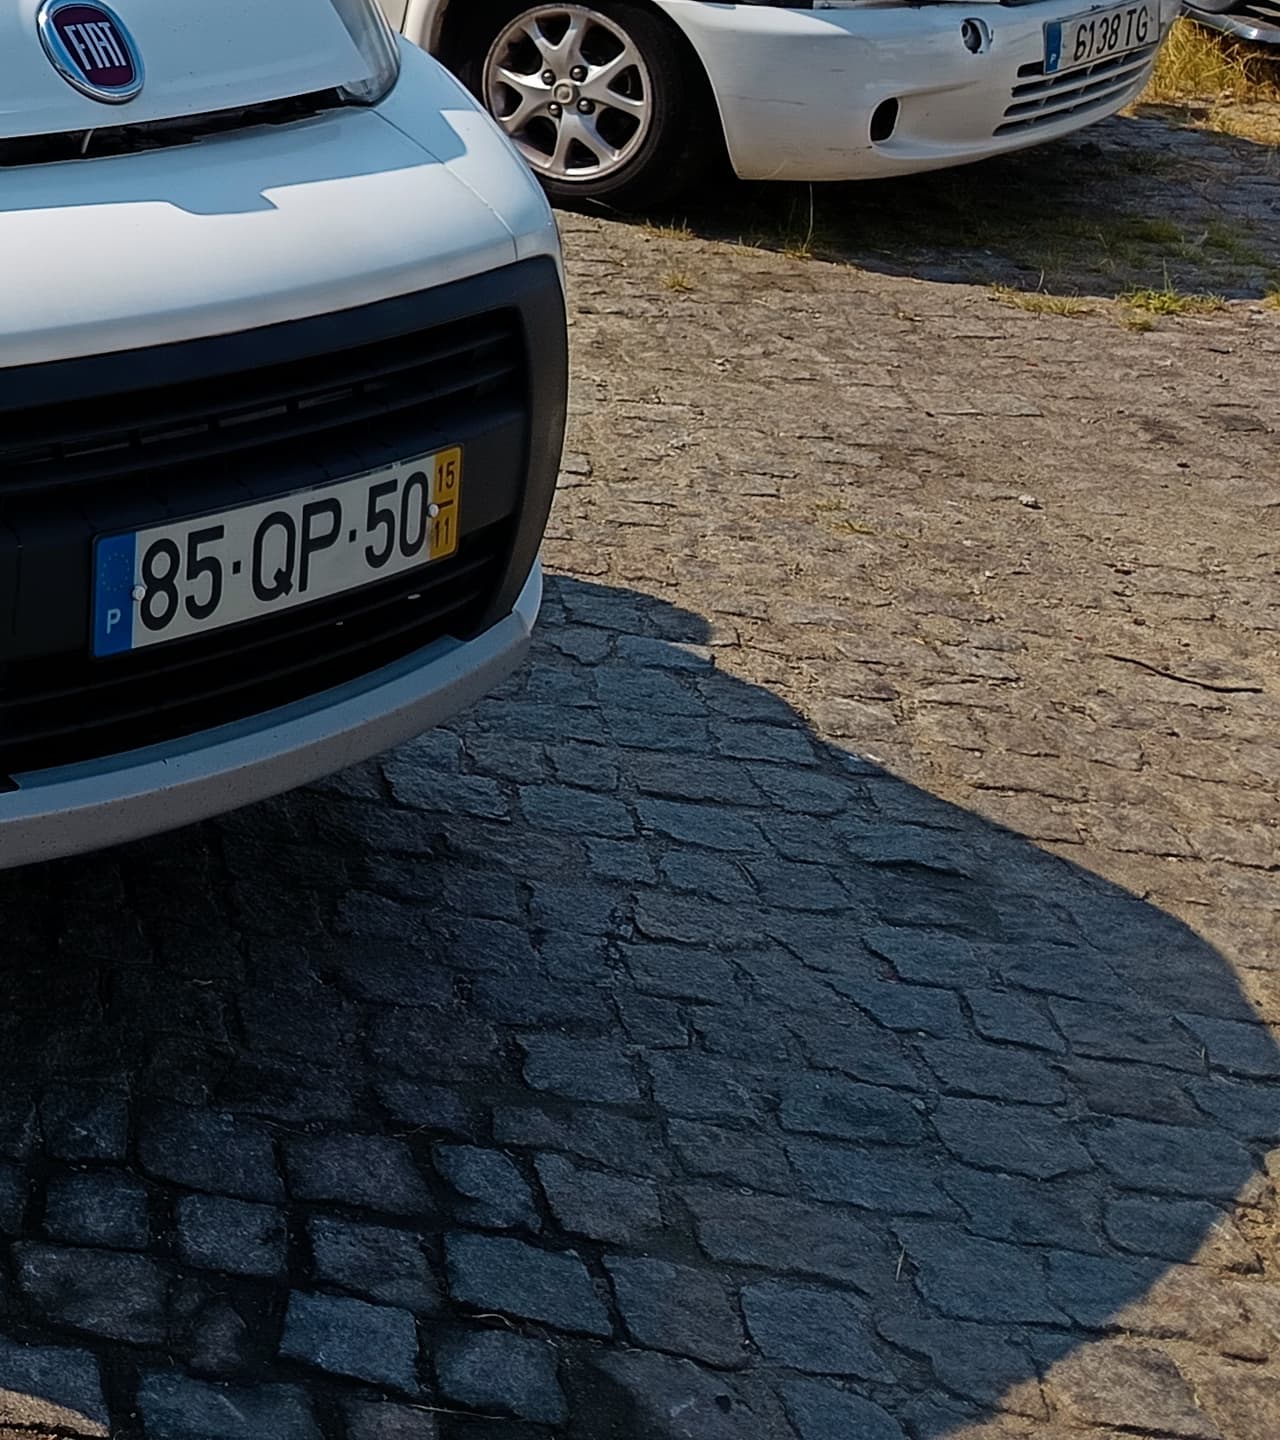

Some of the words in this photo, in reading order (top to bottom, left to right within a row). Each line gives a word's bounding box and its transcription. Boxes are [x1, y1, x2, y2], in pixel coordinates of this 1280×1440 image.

[63, 21, 127, 70] FIAT
[1073, 12, 1121, 61] 6138
[1125, 4, 1149, 46] TG
[438, 460, 455, 493] 15
[435, 517, 450, 548] 11
[105, 607, 122, 635] P
